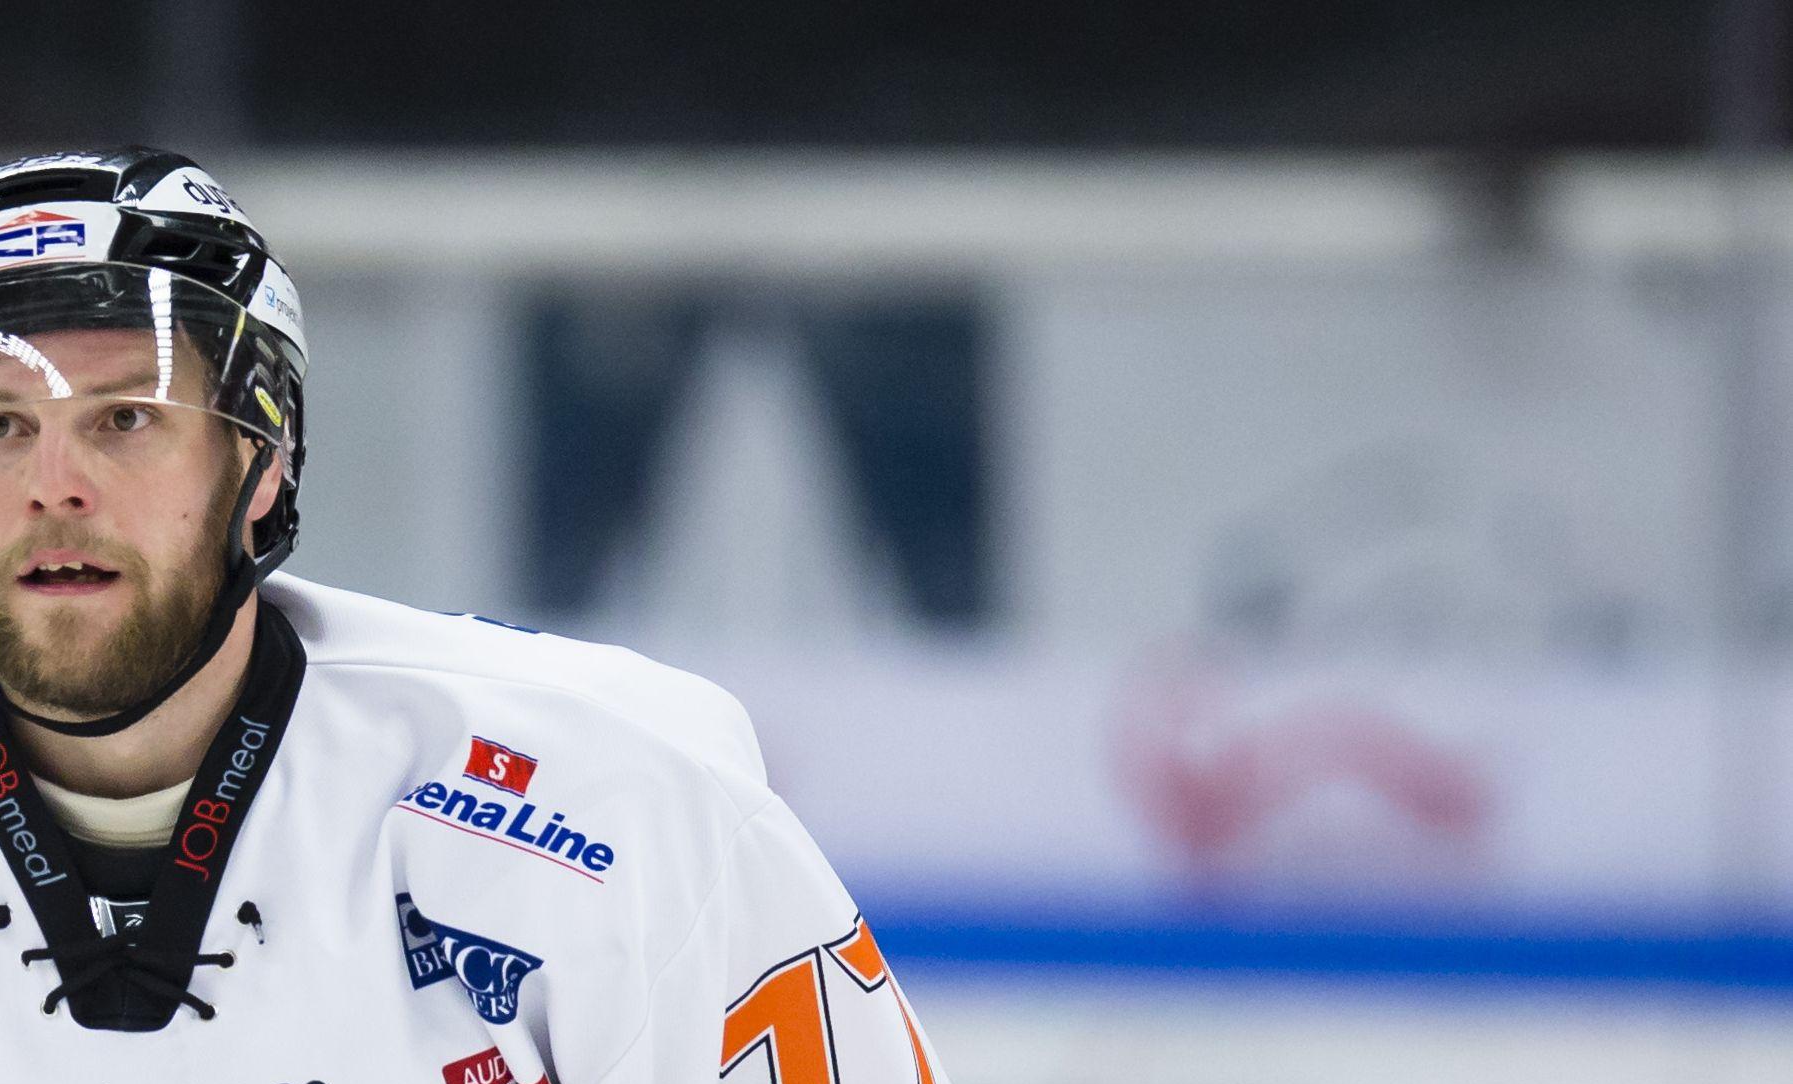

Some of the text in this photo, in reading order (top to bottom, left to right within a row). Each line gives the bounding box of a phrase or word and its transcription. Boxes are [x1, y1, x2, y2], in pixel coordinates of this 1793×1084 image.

[174, 715, 271, 881] JOBmeal
[488, 752, 511, 783] S
[403, 781, 615, 872] ena Line
